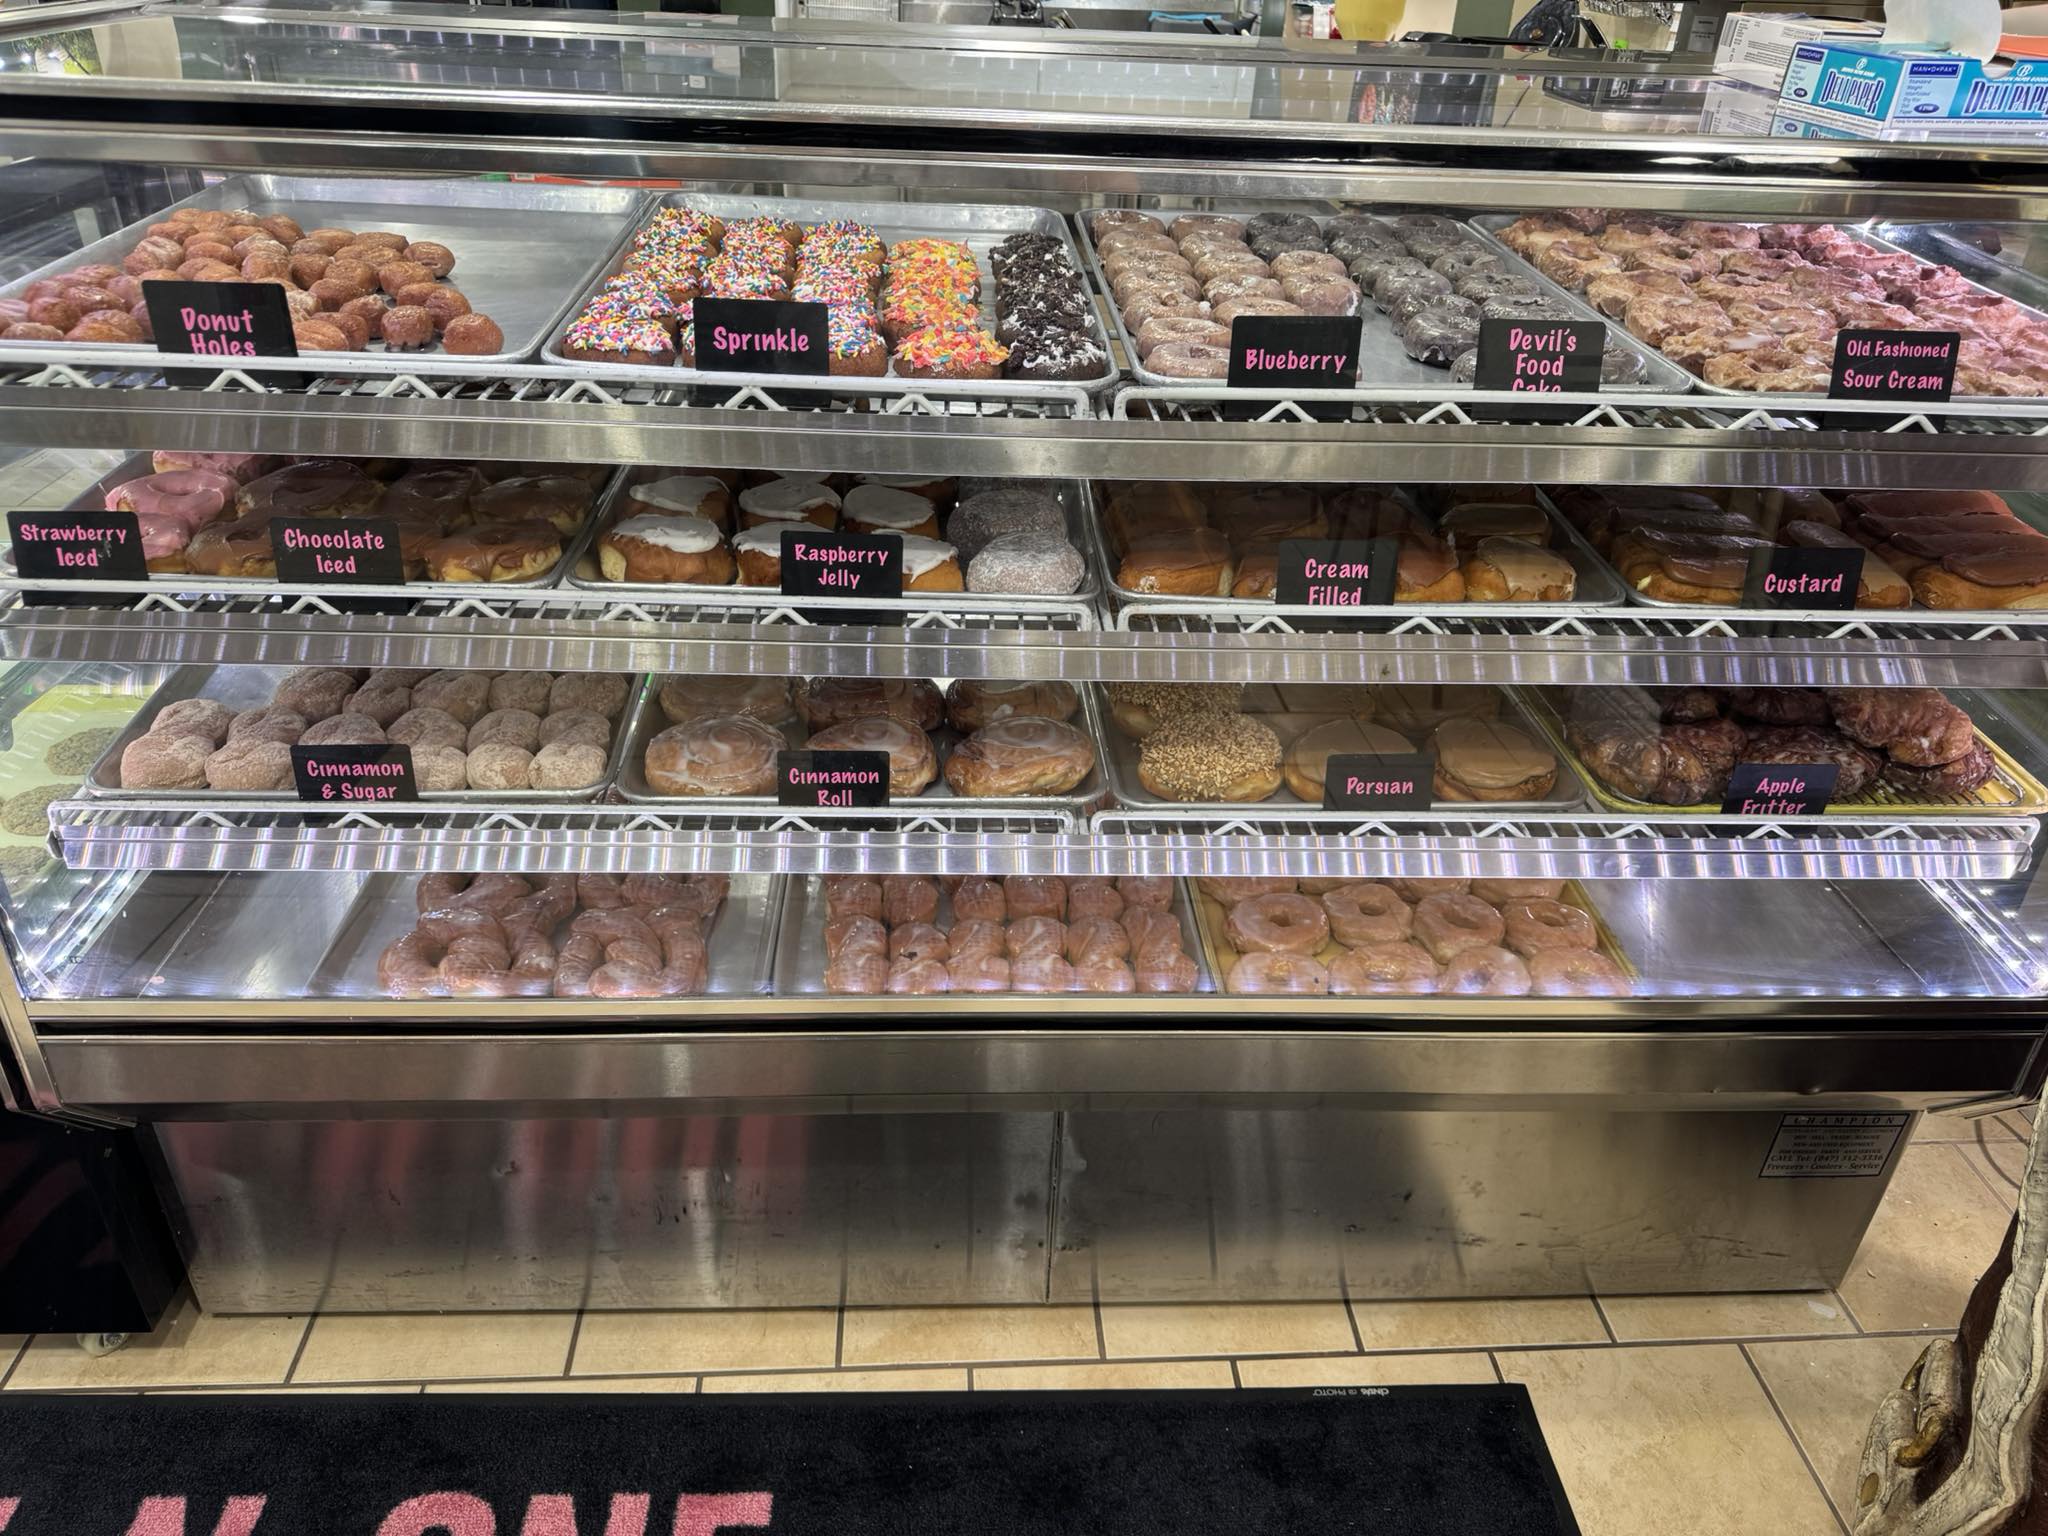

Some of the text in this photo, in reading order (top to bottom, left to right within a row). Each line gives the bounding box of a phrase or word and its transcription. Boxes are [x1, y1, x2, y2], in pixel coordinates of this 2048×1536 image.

[1846, 77, 1886, 115] PAPER
[1963, 79, 2009, 114] DELI
[2006, 84, 2048, 116] PAPE
[180, 307, 254, 333] Donut
[190, 333, 256, 356] Holes
[713, 326, 810, 355] Sprinkle
[1509, 328, 1577, 352] Devil's
[1847, 340, 1951, 358] Old Fashioned
[1245, 348, 1347, 374] Blueberry
[1515, 353, 1565, 376] Food
[1843, 368, 1943, 390] Sour Cream
[20, 523, 127, 544] Strawberry
[284, 528, 385, 550] Chocolate
[56, 547, 99, 567] Iced
[316, 554, 357, 574] Iced
[794, 543, 889, 567] Raspberry
[818, 568, 861, 590] Jelly
[1305, 558, 1369, 579] Cream
[1764, 573, 1844, 593] Custard
[1308, 585, 1362, 607] Filled
[306, 760, 404, 777] Cinnamon
[789, 767, 880, 785] Cinnamon
[321, 782, 398, 802] & Sugar
[1346, 776, 1414, 795] Persian
[1755, 777, 1806, 797] Apple
[817, 789, 853, 807] Roll
[1741, 799, 1807, 815] Fritter
[1794, 1116, 1896, 1124] CHAMPION
